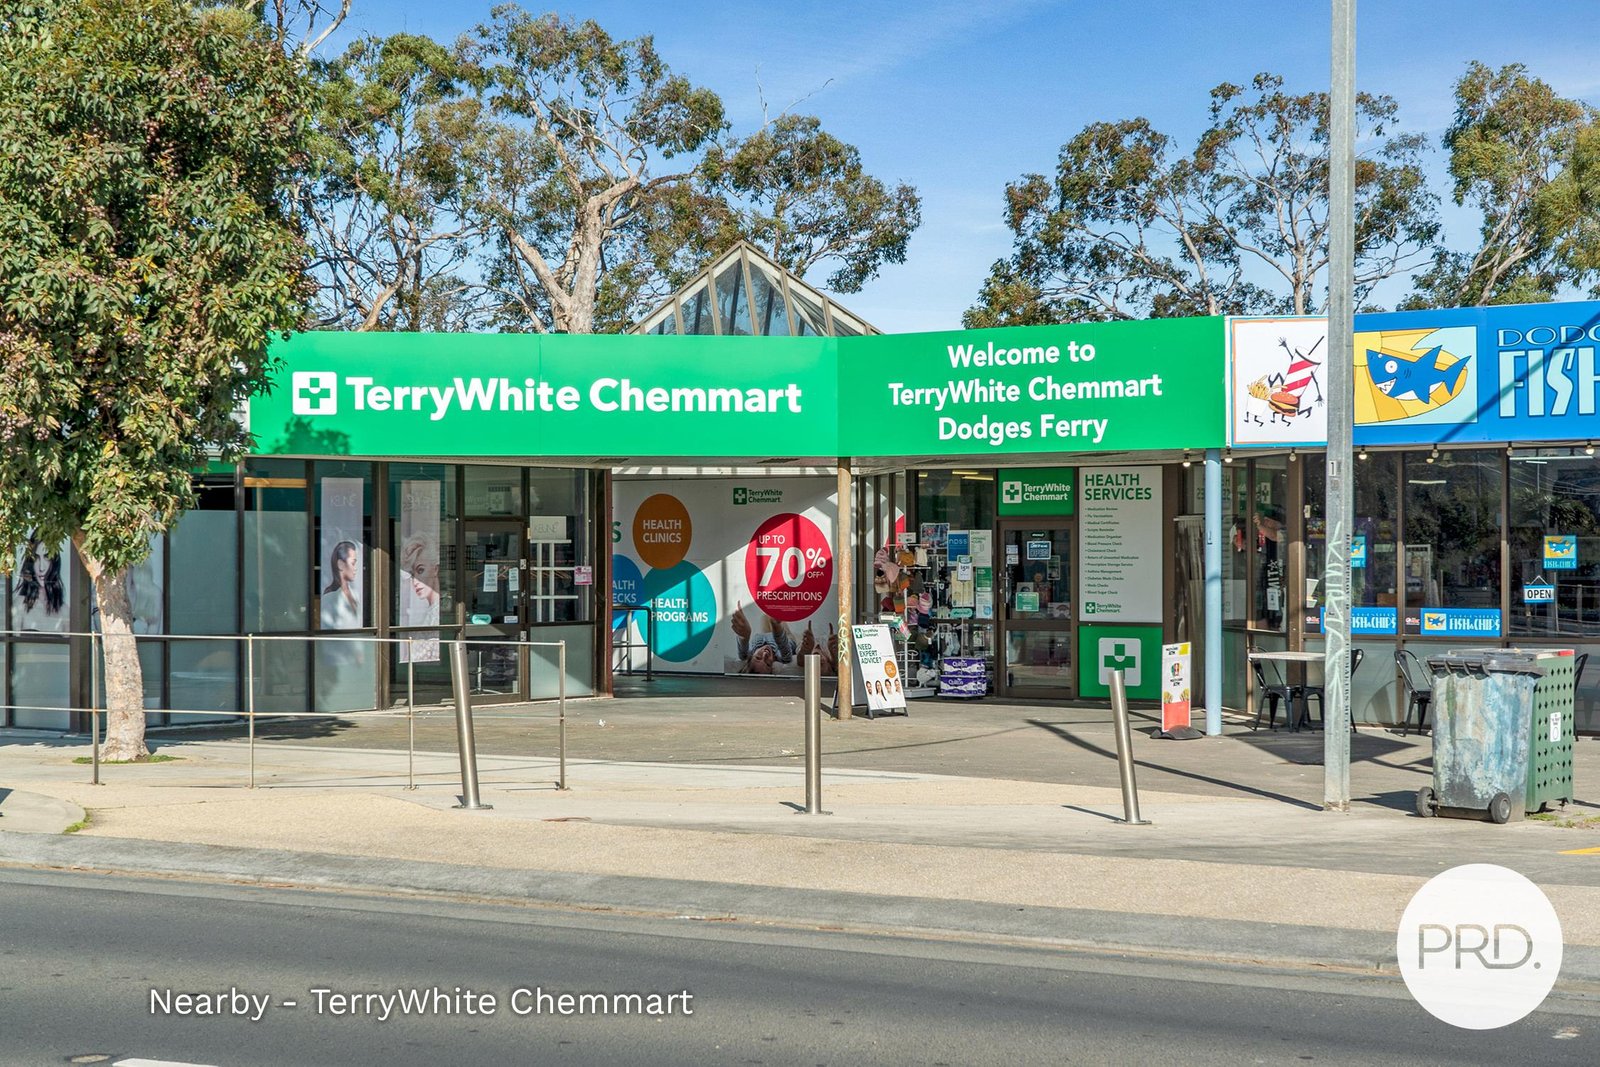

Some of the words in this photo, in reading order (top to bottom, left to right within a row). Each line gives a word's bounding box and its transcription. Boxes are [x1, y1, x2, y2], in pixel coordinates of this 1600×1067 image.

[947, 342, 1059, 369] Welcome
[1067, 340, 1096, 362] to
[888, 378, 1021, 411] TerryWhite
[1028, 374, 1163, 400] Chemmart
[345, 377, 581, 421] TerryWhite
[589, 377, 802, 413] Chemmart
[938, 415, 1032, 446] Dodges
[1040, 413, 1109, 443] Ferry
[1085, 474, 1140, 486] HEALTH
[748, 489, 783, 497] TerryWhite
[1023, 483, 1071, 493] TerryWhite
[1023, 492, 1068, 501] Chemmart
[1085, 488, 1152, 500] SERVICES
[643, 520, 682, 530] HEALTH
[643, 533, 682, 543] CLINICS
[758, 535, 771, 544] UP
[773, 535, 785, 544] TO
[756, 547, 827, 588] 70%
[612, 580, 635, 590] ALTH
[612, 593, 637, 603] ECKS
[757, 591, 822, 601] PRESCRIPTIONS
[1527, 589, 1551, 599] OPEN
[650, 599, 689, 609] HEALTH
[650, 612, 709, 622] PROGRAMS
[861, 656, 882, 664] ADVICE?
